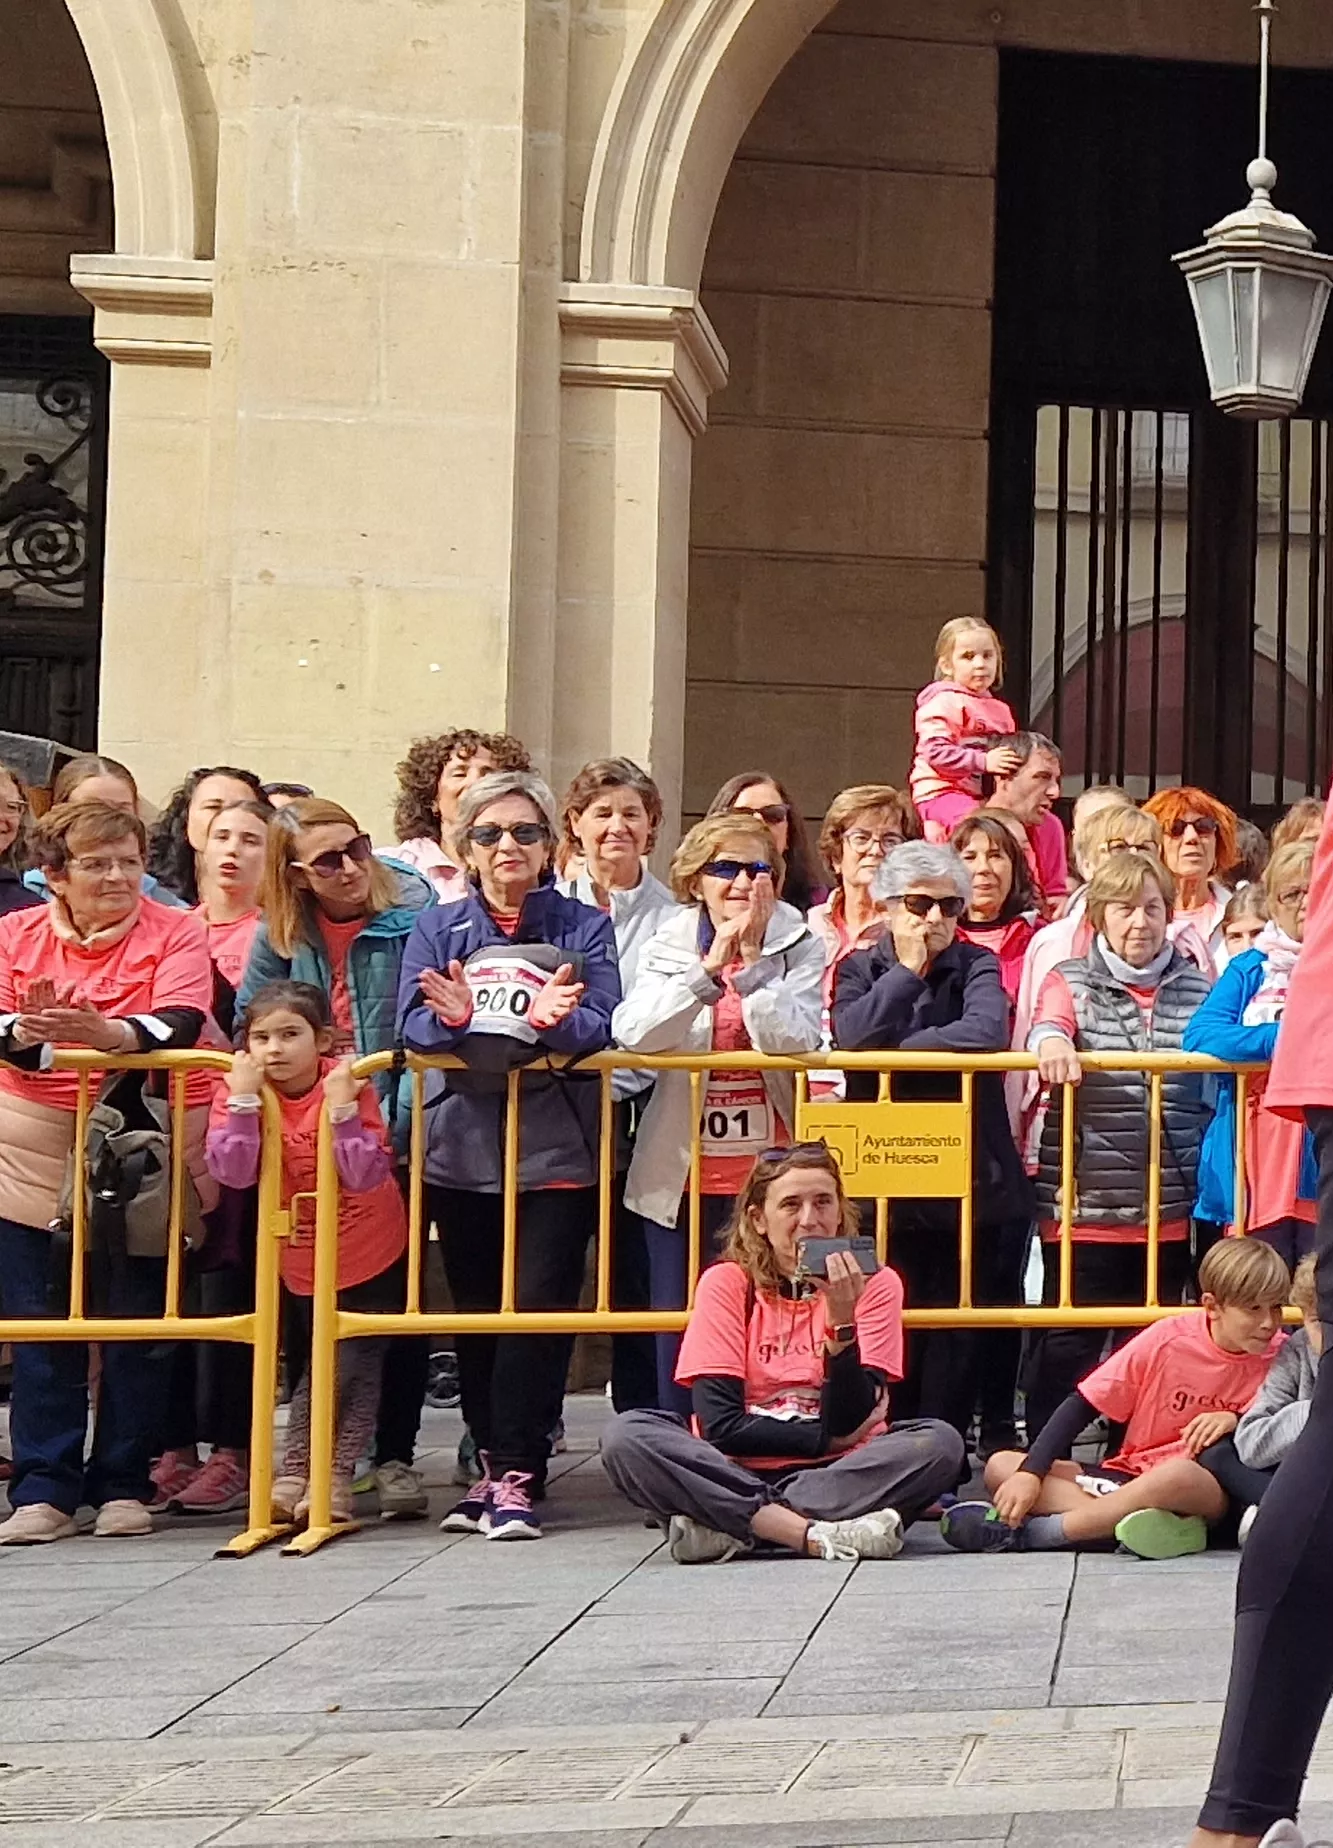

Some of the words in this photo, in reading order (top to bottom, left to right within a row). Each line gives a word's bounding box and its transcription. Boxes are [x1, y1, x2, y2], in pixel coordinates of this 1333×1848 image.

[863, 1133, 961, 1149] Ayuntamiento
[862, 1152, 881, 1164] de
[885, 1151, 939, 1164] Huesca
